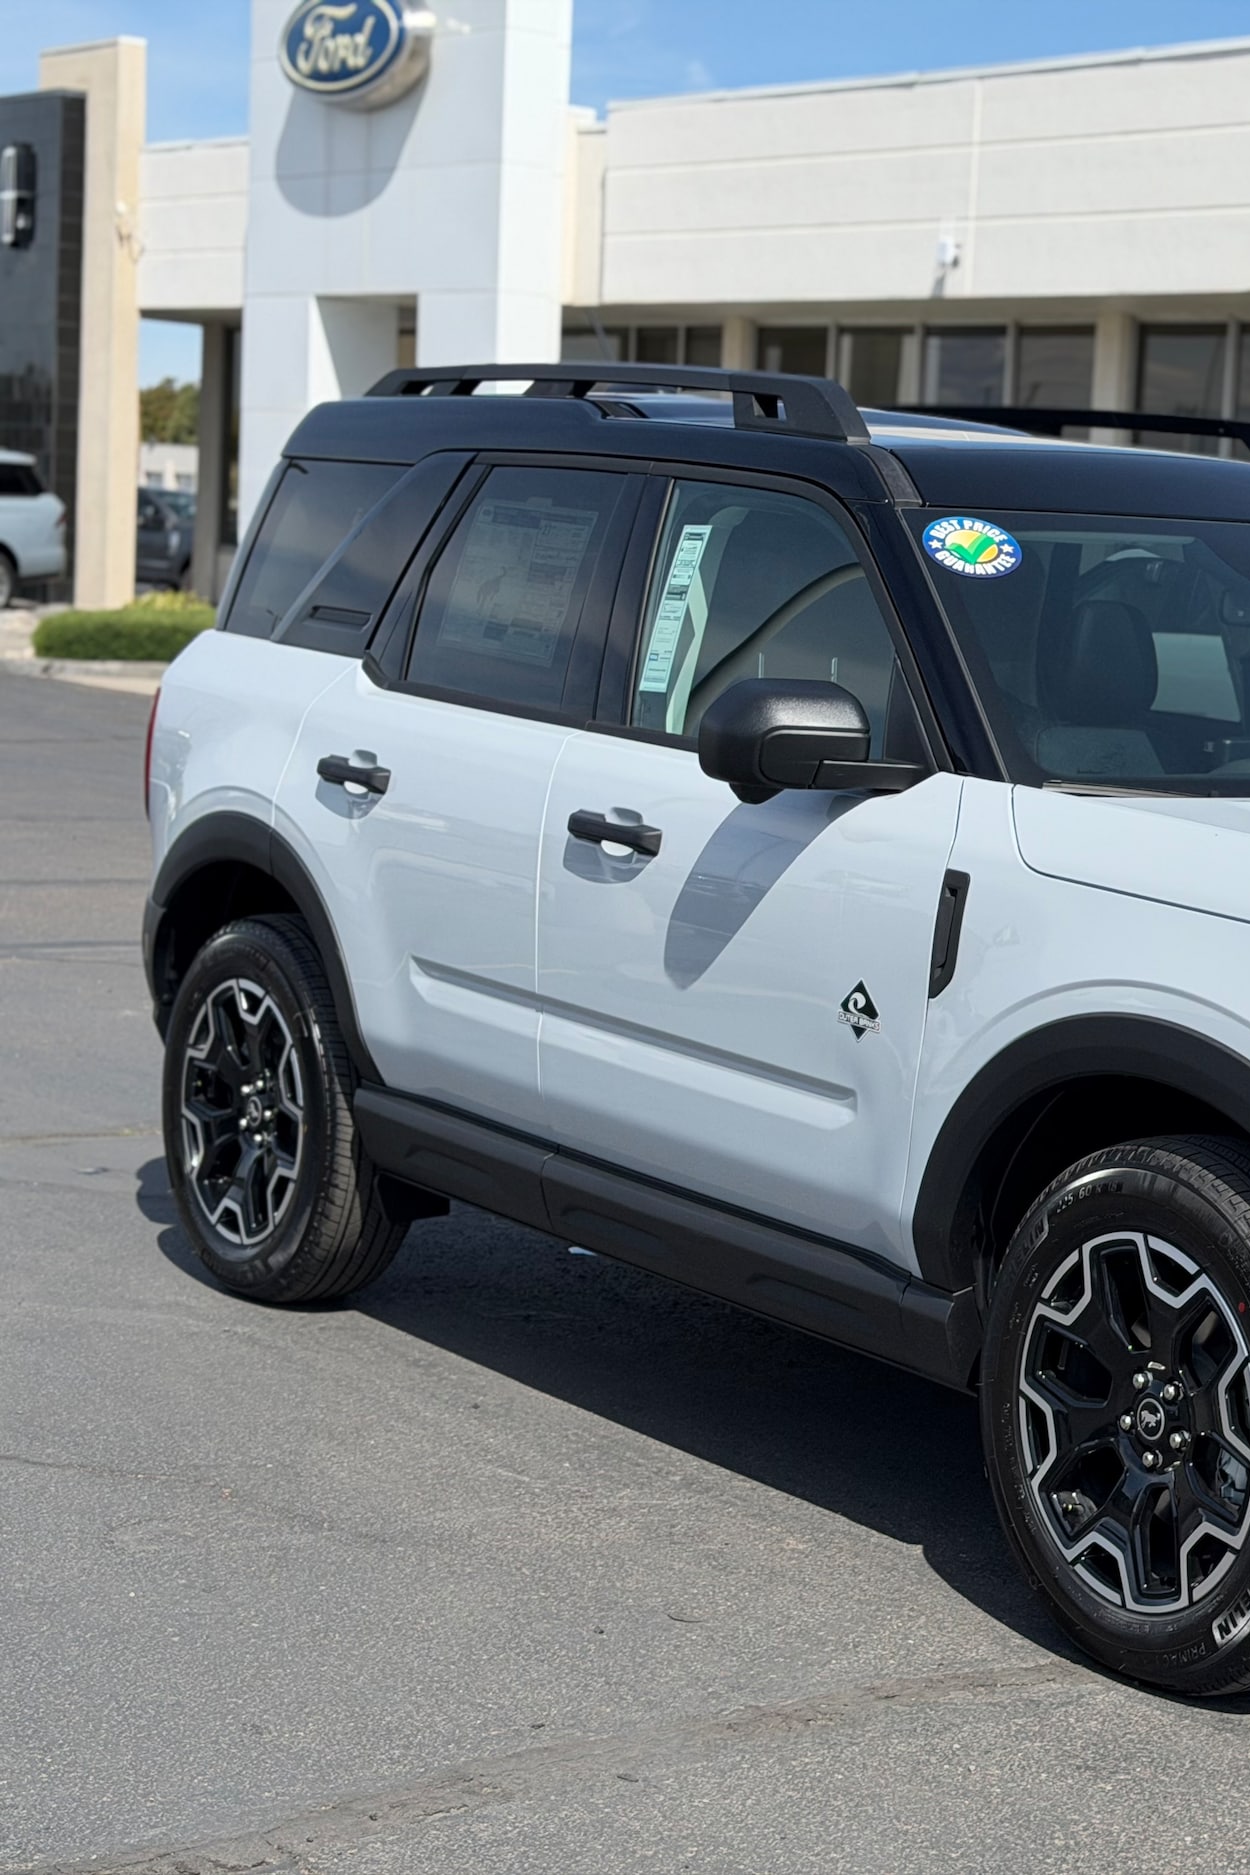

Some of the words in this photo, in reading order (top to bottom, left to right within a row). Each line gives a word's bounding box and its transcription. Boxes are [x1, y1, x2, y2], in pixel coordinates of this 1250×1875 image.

[296, 3, 376, 75] Ford
[929, 519, 961, 539] BEST
[963, 519, 1008, 542] PRICE
[934, 553, 1017, 575] GUARANTEE
